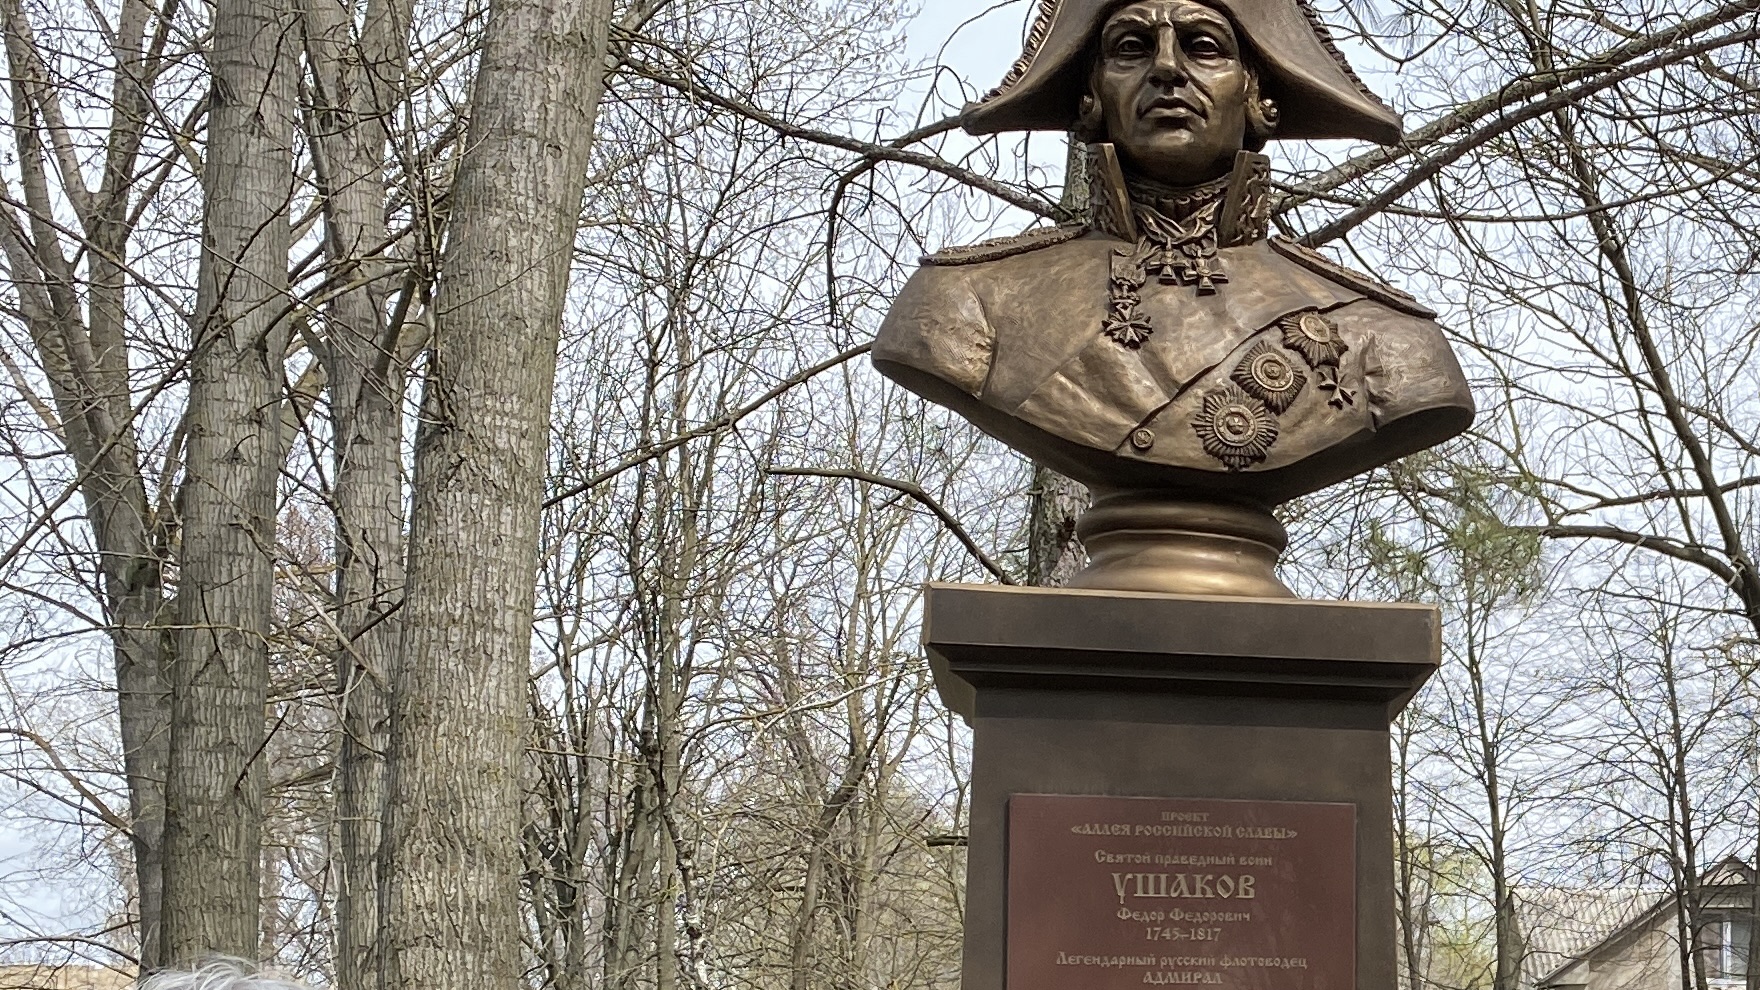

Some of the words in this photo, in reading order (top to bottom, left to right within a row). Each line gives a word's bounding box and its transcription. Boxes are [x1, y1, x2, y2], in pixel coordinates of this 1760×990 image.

[1161, 811, 1210, 822] ПРОЕКТ
[1071, 823, 1131, 836] «АЛЛЕЯ
[1134, 825, 1233, 838] РОССИЙСКОЙ
[1235, 827, 1298, 839] СЛАВЫ»
[1095, 849, 1151, 864] Святой
[1155, 852, 1235, 867] праведный
[1239, 855, 1272, 866] воин
[1111, 872, 1256, 904] УШАКОВ
[1117, 907, 1164, 922] Федор
[1169, 907, 1251, 923] Федорович
[1056, 951, 1156, 968] Легендарный
[1160, 953, 1215, 969] русский
[1219, 955, 1308, 968] флотоводец
[1143, 971, 1223, 984] АДМИРАЛ
